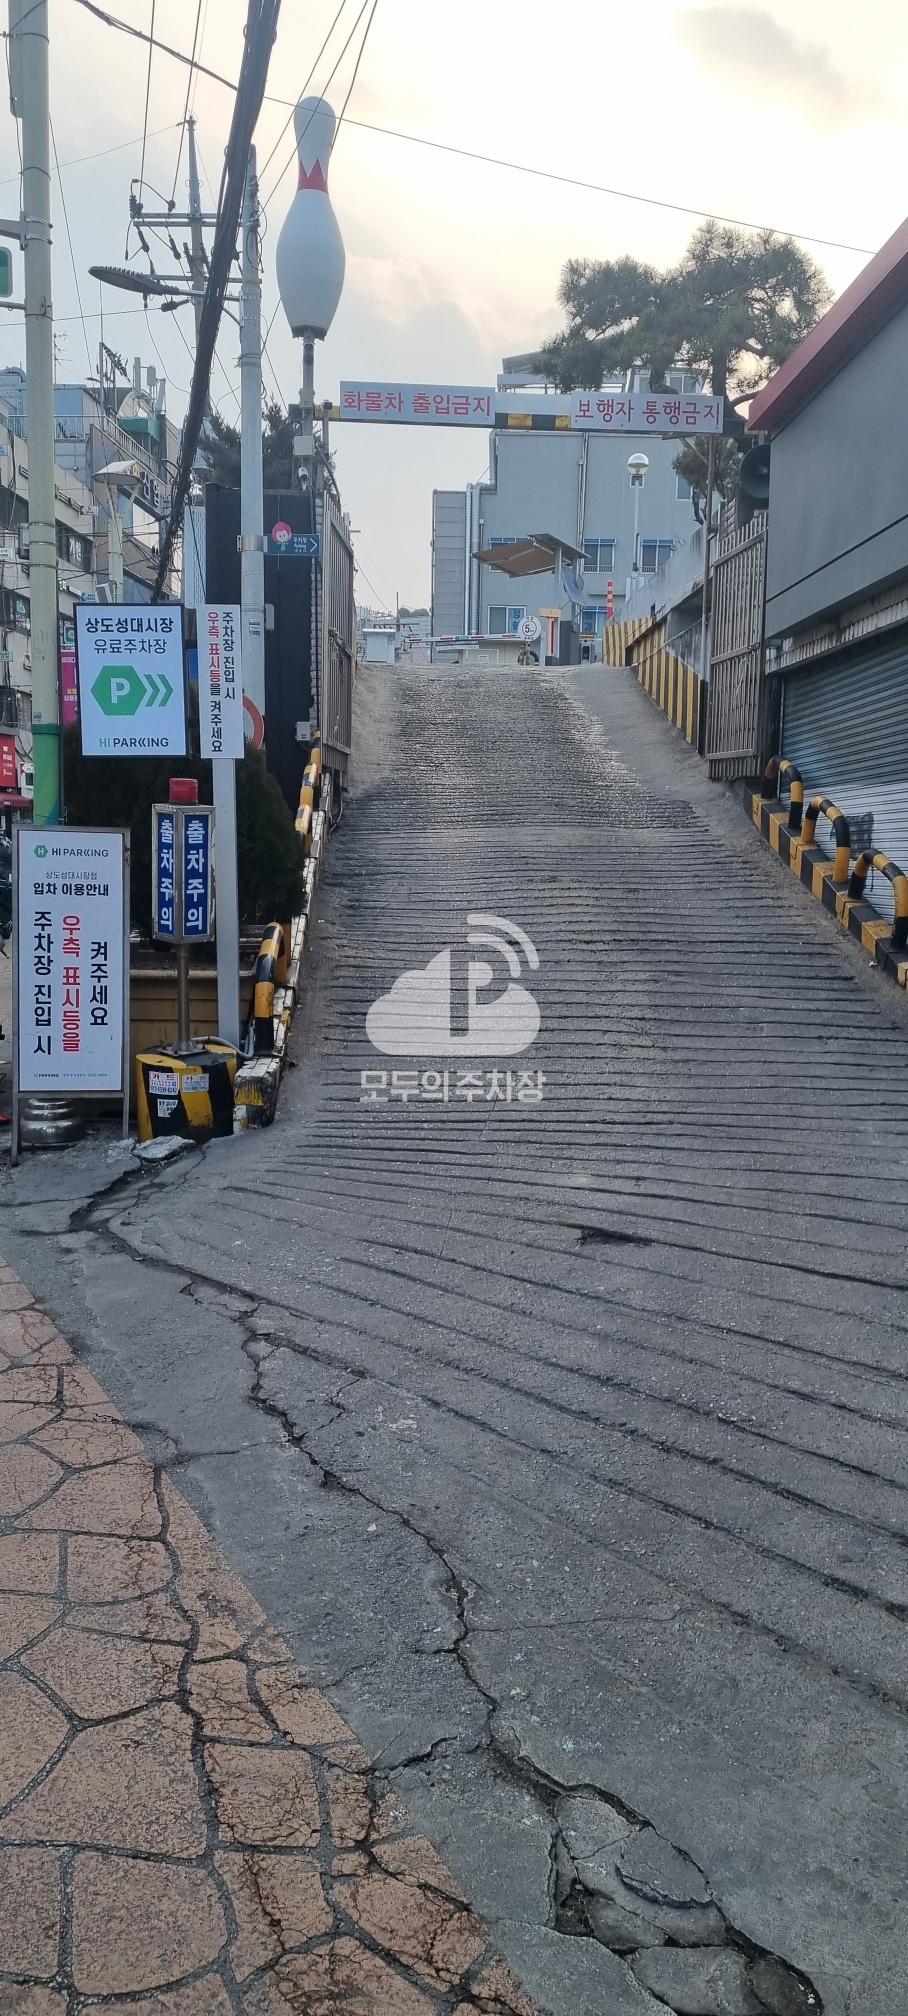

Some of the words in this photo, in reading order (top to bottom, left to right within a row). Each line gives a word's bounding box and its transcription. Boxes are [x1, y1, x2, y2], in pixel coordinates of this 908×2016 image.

[343, 389, 404, 413] 화물차
[412, 391, 491, 417] 출입금지
[575, 398, 635, 423] 보행자
[642, 399, 720, 427] 통행금지
[84, 616, 175, 635] 상도성대시장
[207, 611, 220, 639] 우측
[222, 611, 235, 652] 주차장
[93, 638, 168, 655] 유료주차장
[208, 642, 222, 697] 표시등을
[223, 656, 235, 683] 진입
[224, 688, 236, 700] 시
[210, 701, 223, 753] 켜주세요
[99, 738, 111, 749] HI
[51, 848, 61, 856] HI
[45, 871, 98, 881] 상도성대시장점
[160, 818, 175, 931] 출차주의
[186, 819, 205, 931] 출차주의
[33, 882, 57, 896] 입차
[61, 883, 109, 897] 이용안내
[33, 911, 54, 976] 주차장
[61, 914, 81, 959] 우측
[89, 940, 109, 1027] 켜주세요
[33, 984, 52, 1028] 진입
[61, 966, 81, 1053] 표시등을
[33, 1035, 52, 1056] 시
